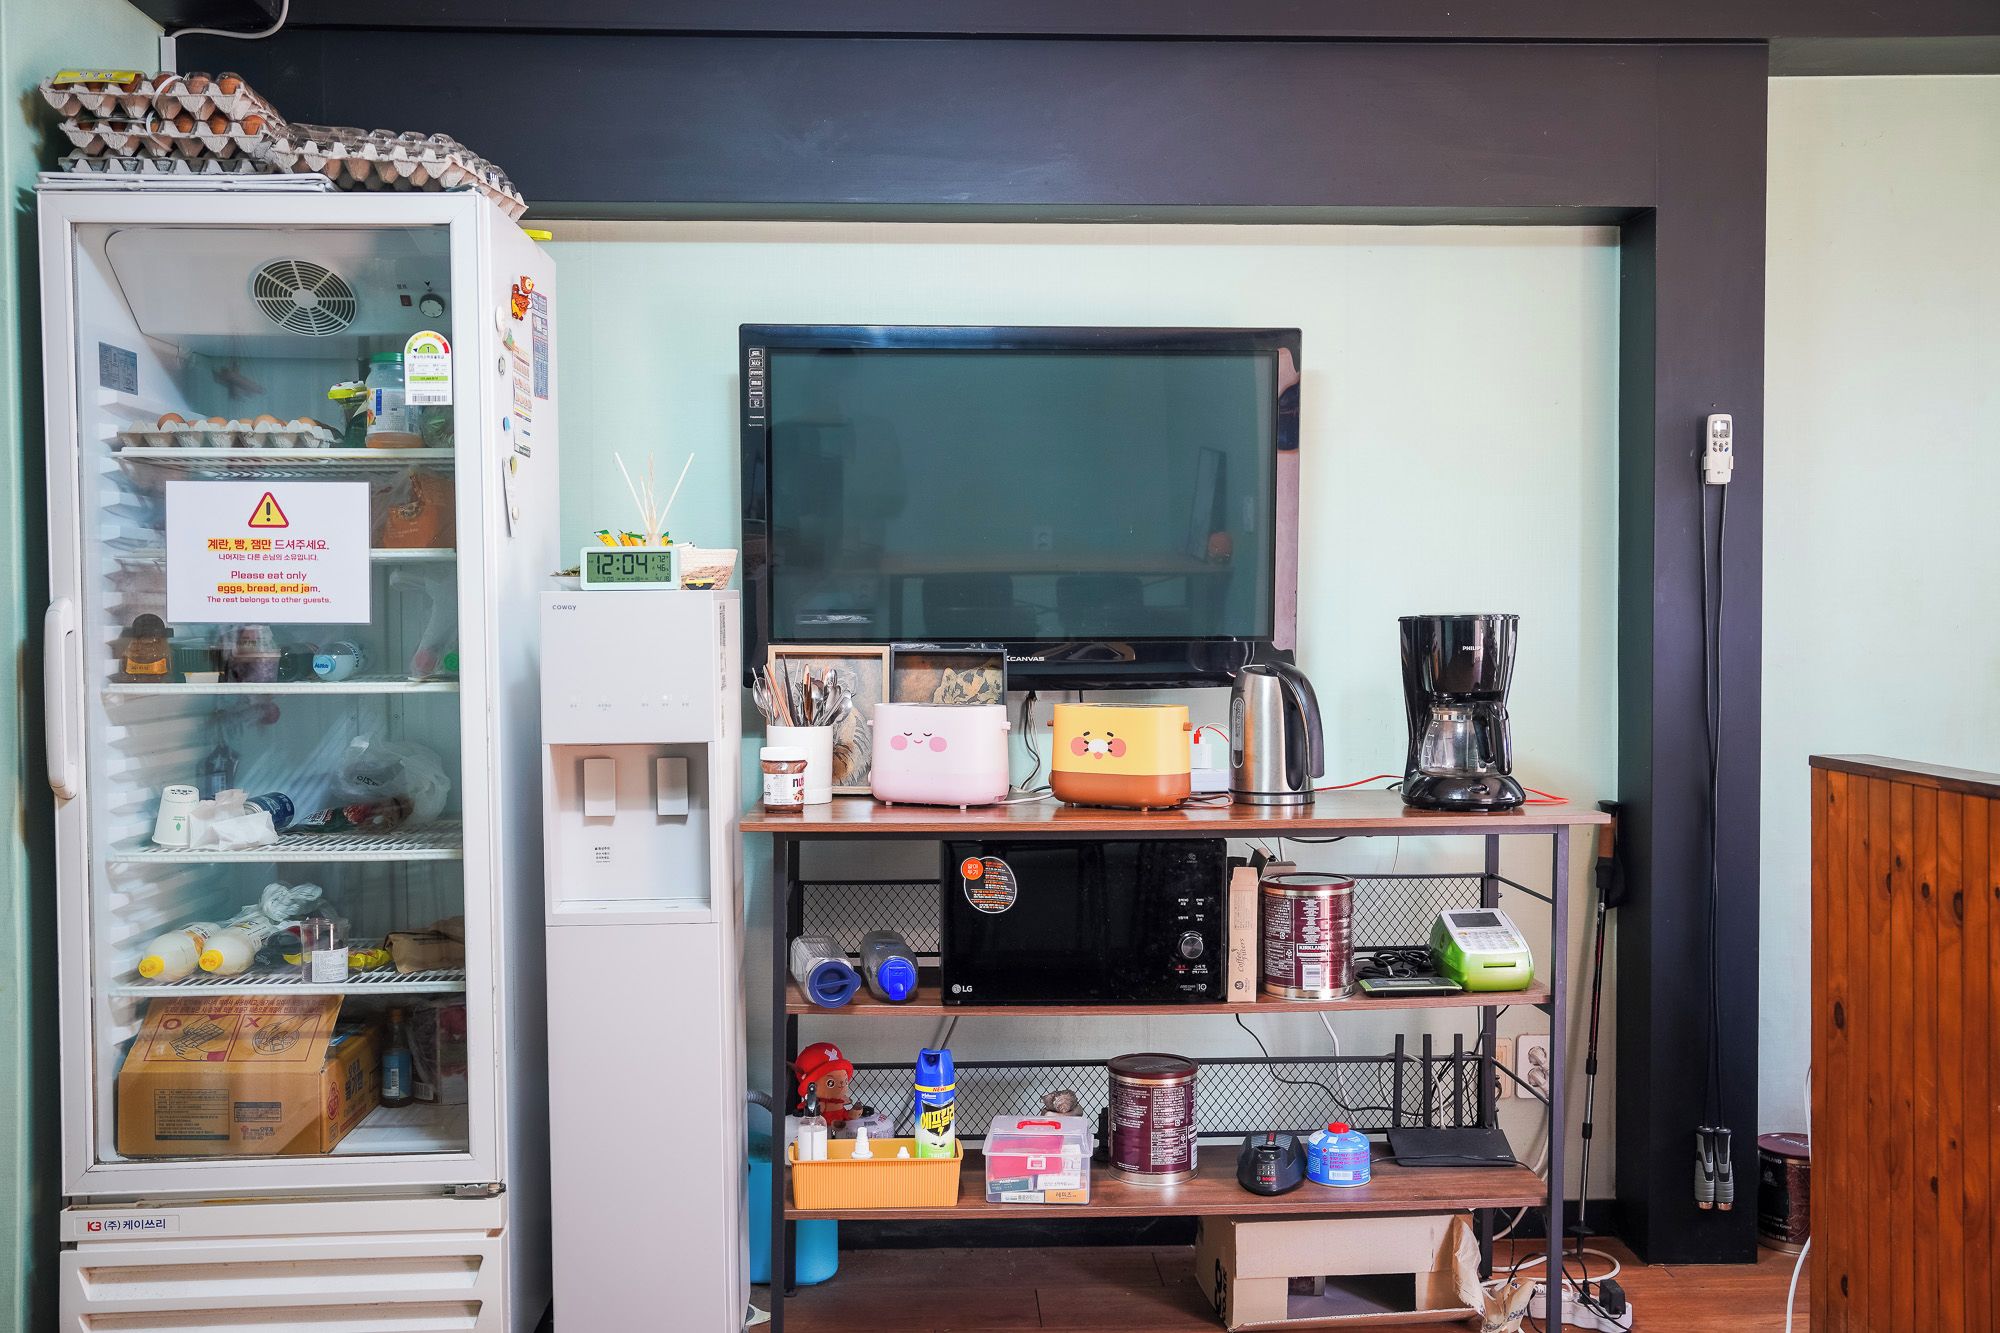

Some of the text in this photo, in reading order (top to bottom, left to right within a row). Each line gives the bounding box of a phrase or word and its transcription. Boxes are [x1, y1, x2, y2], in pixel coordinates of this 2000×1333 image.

[207, 539, 330, 551] 계란, 빵, 잼만 드셔주세요.
[218, 553, 319, 561] 나머지는 다른 손님의 소유입니다.
[596, 554, 648, 575] 12:04
[231, 570, 307, 581] Please eat only
[217, 583, 321, 594] eggs, bread, and jam.
[207, 595, 221, 603] The
[239, 595, 270, 605] belongs
[281, 595, 301, 603] other
[302, 596, 332, 605] guests.
[962, 985, 973, 993] LG
[122, 1218, 166, 1231] 케이쓰리
